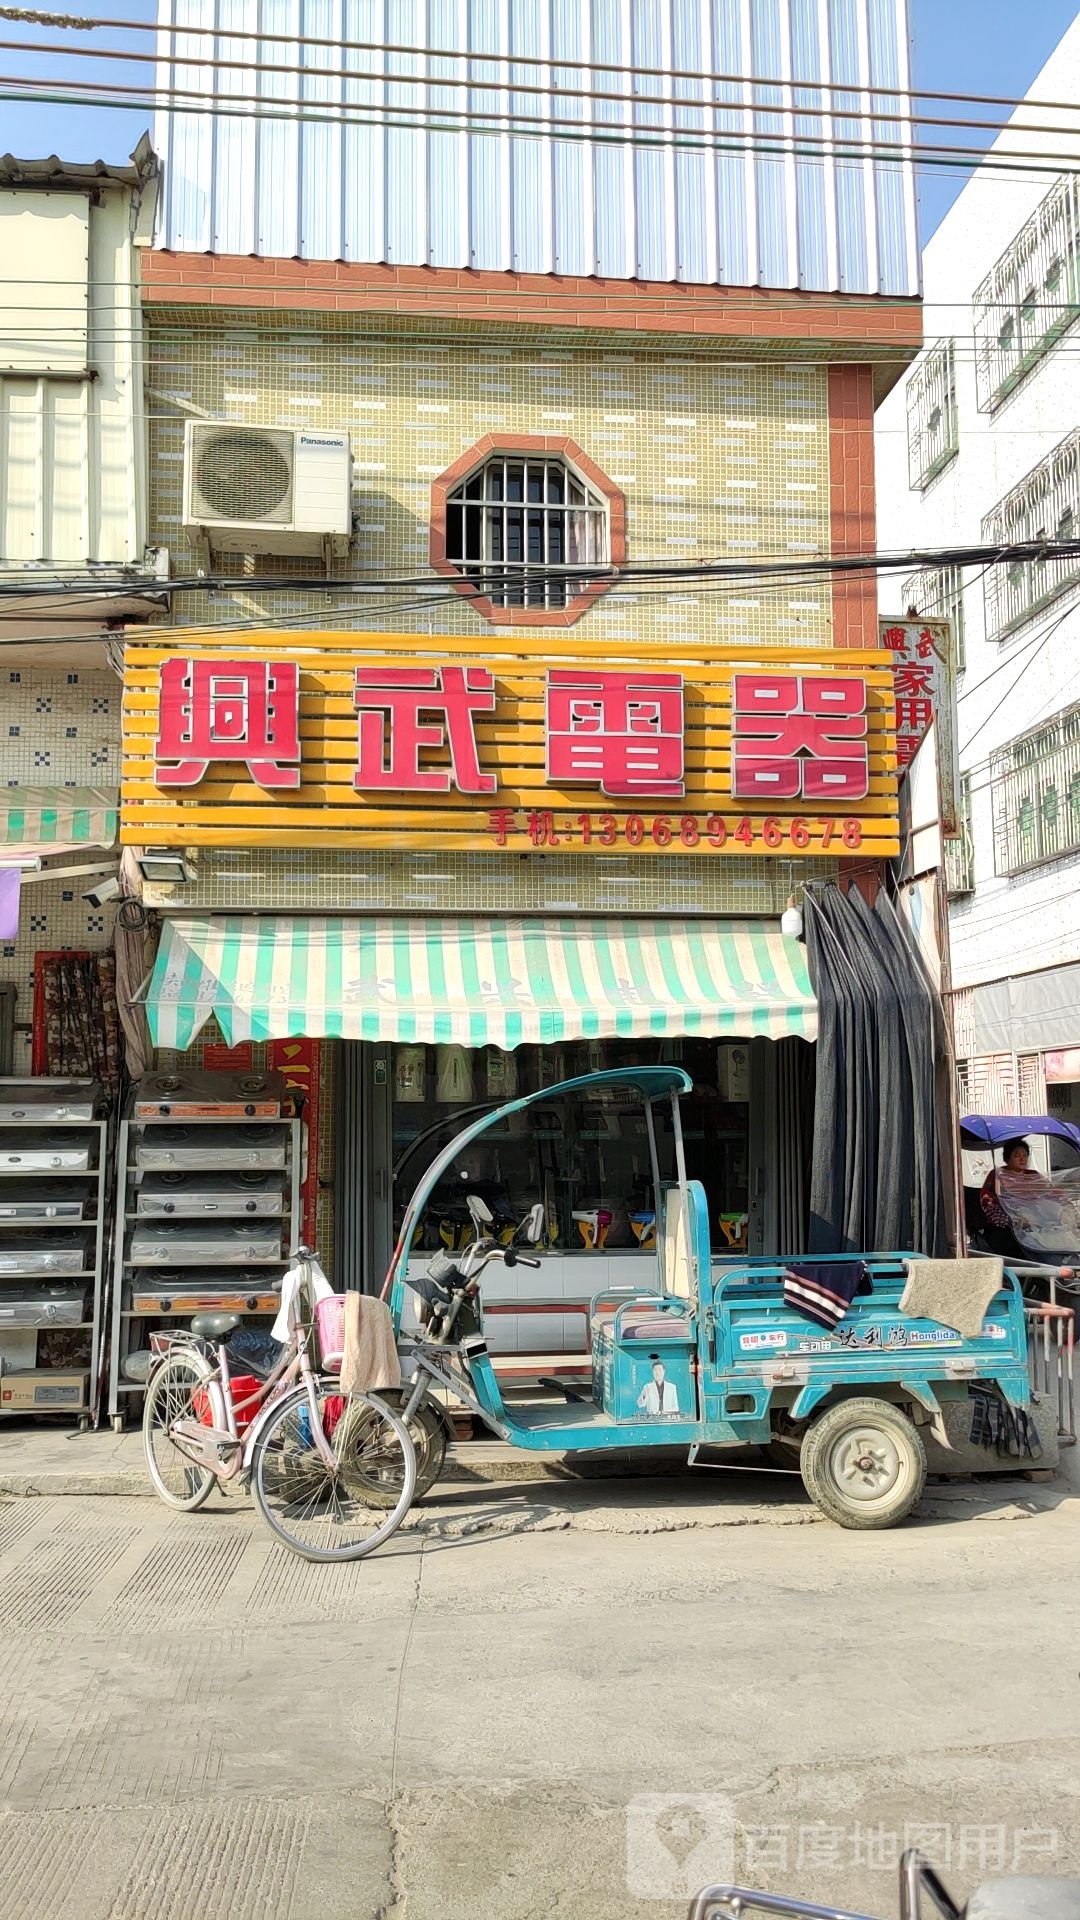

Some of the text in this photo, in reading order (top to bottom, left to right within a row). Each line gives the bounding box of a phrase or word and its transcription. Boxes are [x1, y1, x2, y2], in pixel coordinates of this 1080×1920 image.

[300, 436, 344, 447] Panasonic
[882, 626, 947, 664] 興武
[153, 658, 868, 801] 興武電器
[911, 1330, 955, 1342] Honglida
